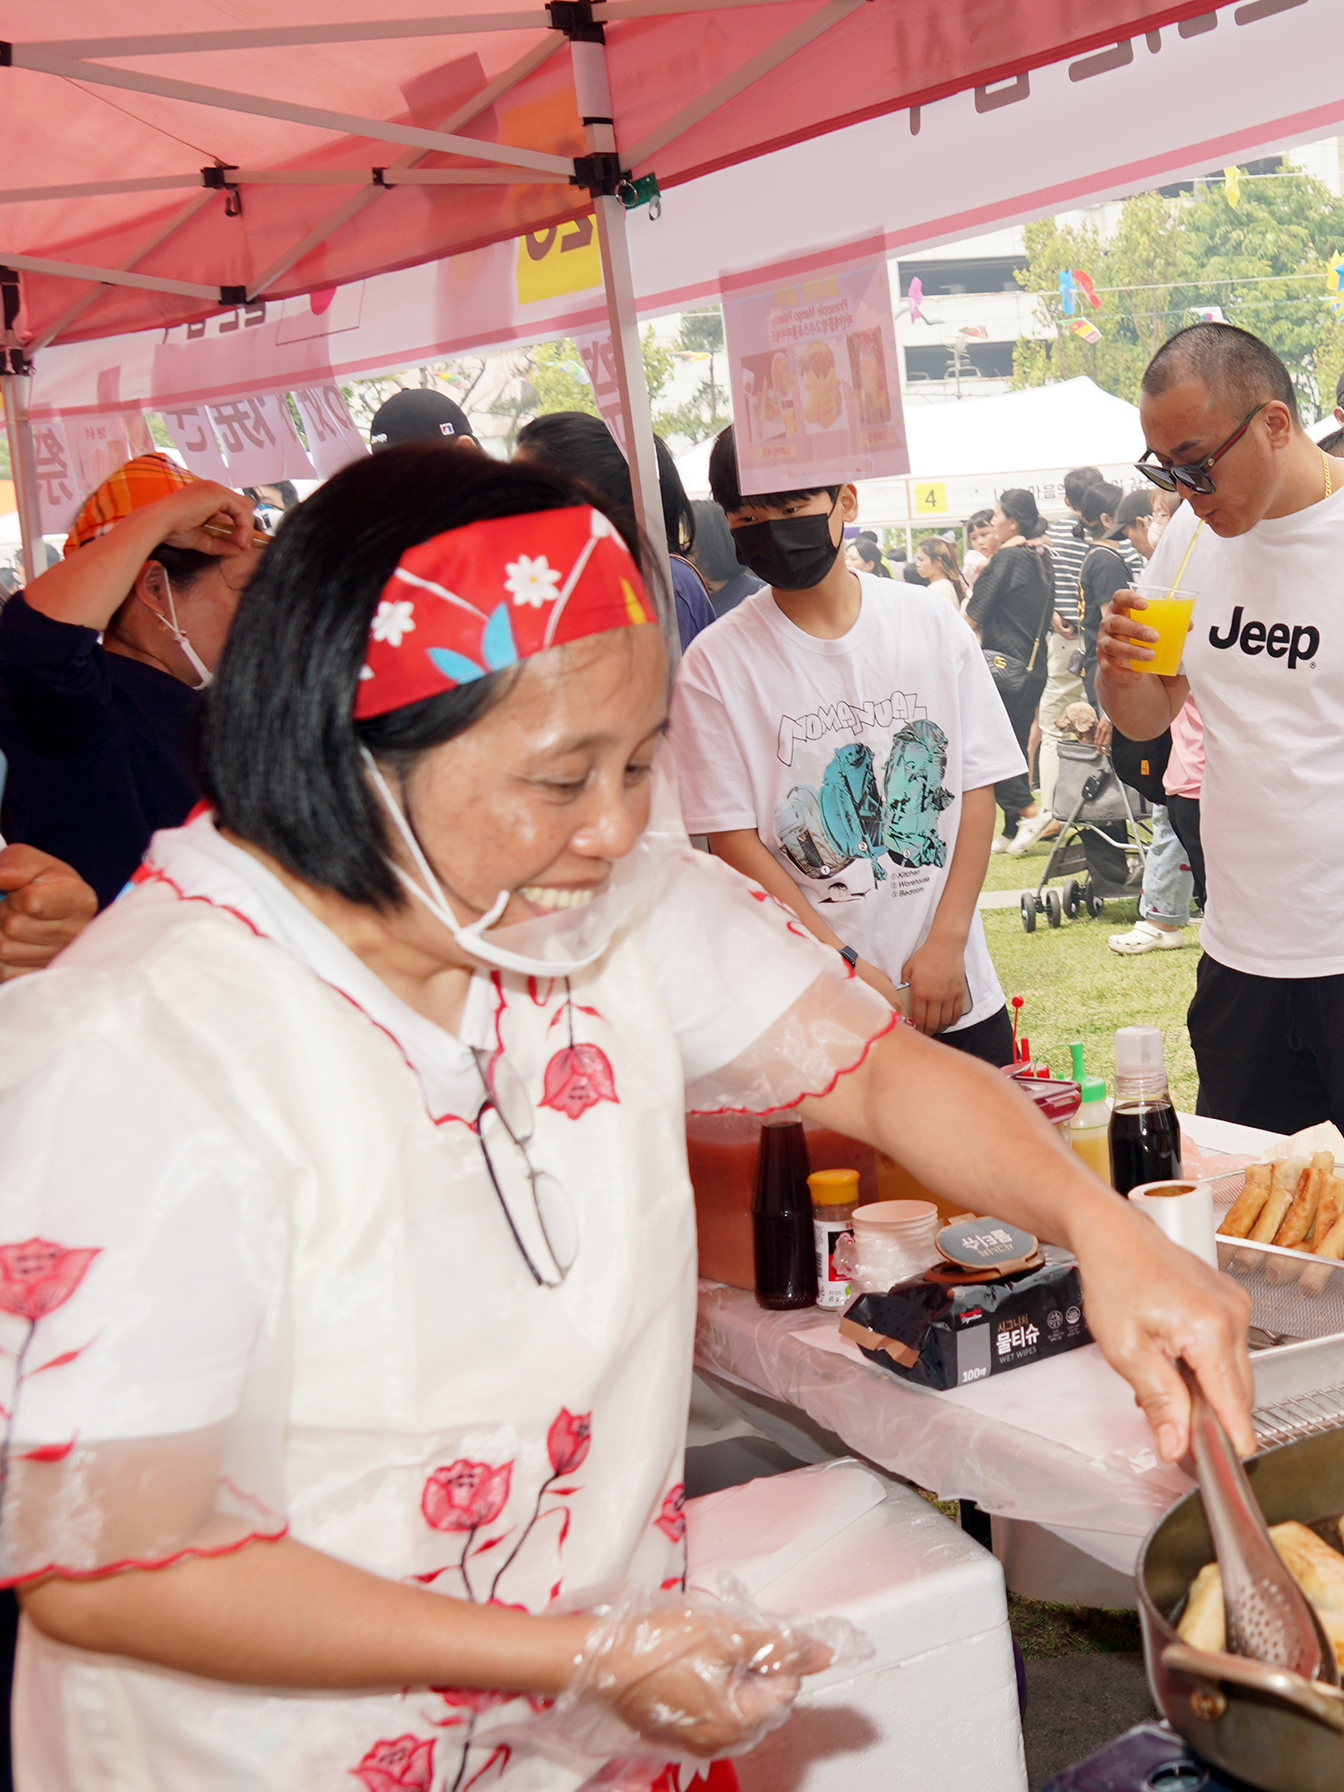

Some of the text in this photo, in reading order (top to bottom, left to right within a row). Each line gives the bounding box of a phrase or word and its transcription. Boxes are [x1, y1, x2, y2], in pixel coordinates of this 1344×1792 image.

[924, 490, 938, 508] 4
[1209, 606, 1320, 669] Jeep
[776, 690, 928, 767] NOMANUAL
[962, 1229, 1013, 1250] 물티슈
[997, 1314, 1029, 1332] 시그니처
[996, 1325, 1040, 1355] 물티슈
[999, 1346, 1037, 1365] WET WIPES
